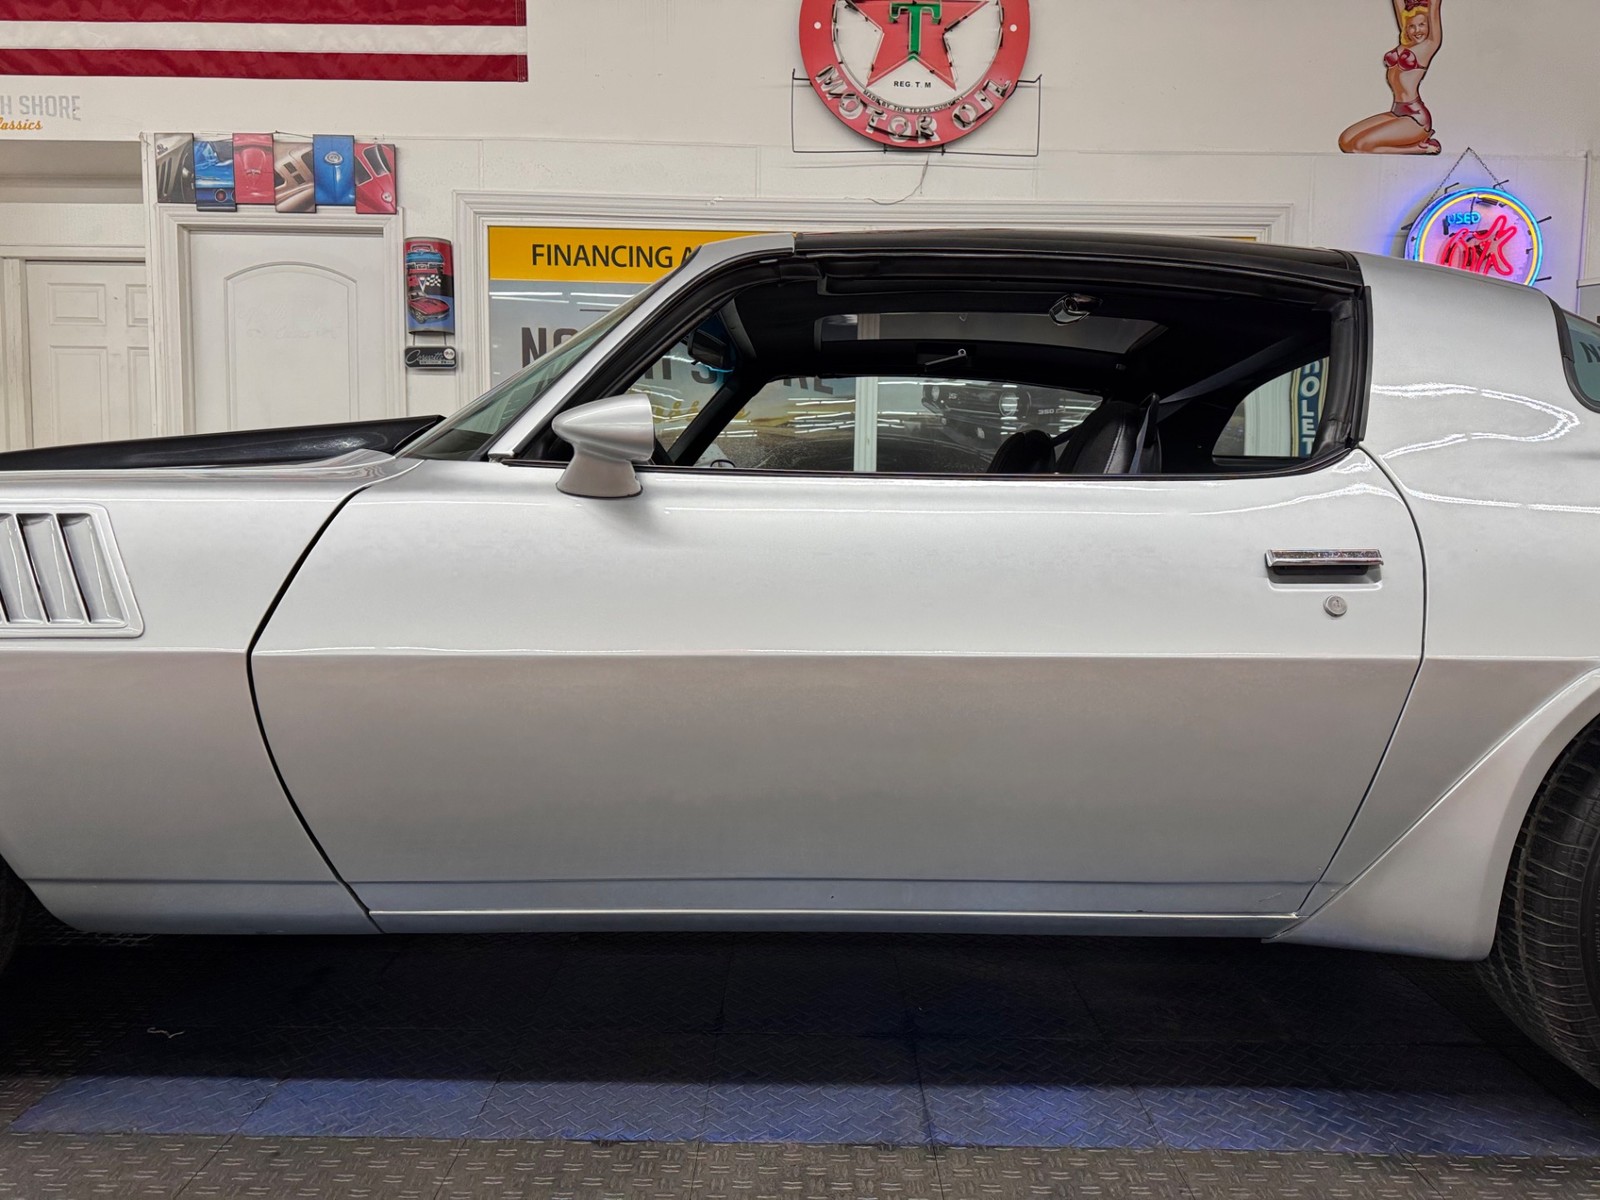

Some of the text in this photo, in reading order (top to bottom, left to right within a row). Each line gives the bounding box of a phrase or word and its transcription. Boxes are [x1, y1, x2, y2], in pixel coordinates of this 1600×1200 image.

[19, 95, 82, 121] SHORE
[815, 64, 1012, 143] MOTOR OIL
[894, 105, 906, 113] THE
[1447, 211, 1481, 225] USED
[532, 244, 673, 268] FINANCING
